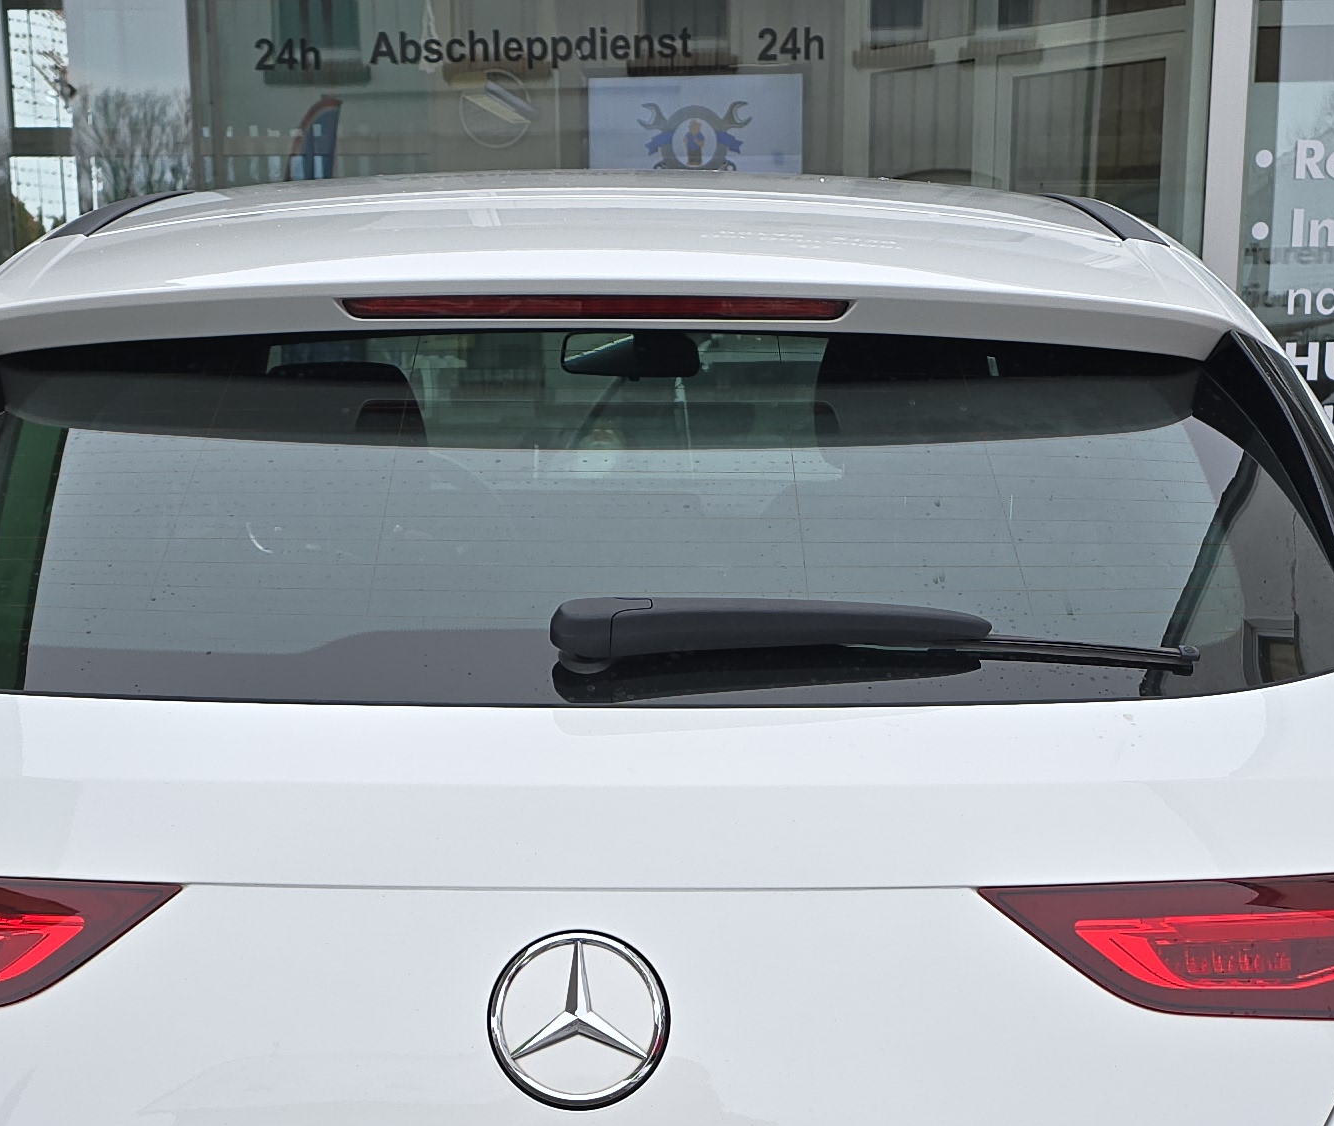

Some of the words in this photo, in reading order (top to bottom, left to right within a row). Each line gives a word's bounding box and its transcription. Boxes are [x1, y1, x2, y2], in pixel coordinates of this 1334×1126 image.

[255, 37, 321, 71] 24h
[369, 26, 692, 69] Abschleppdienst
[757, 26, 824, 61] 24h
